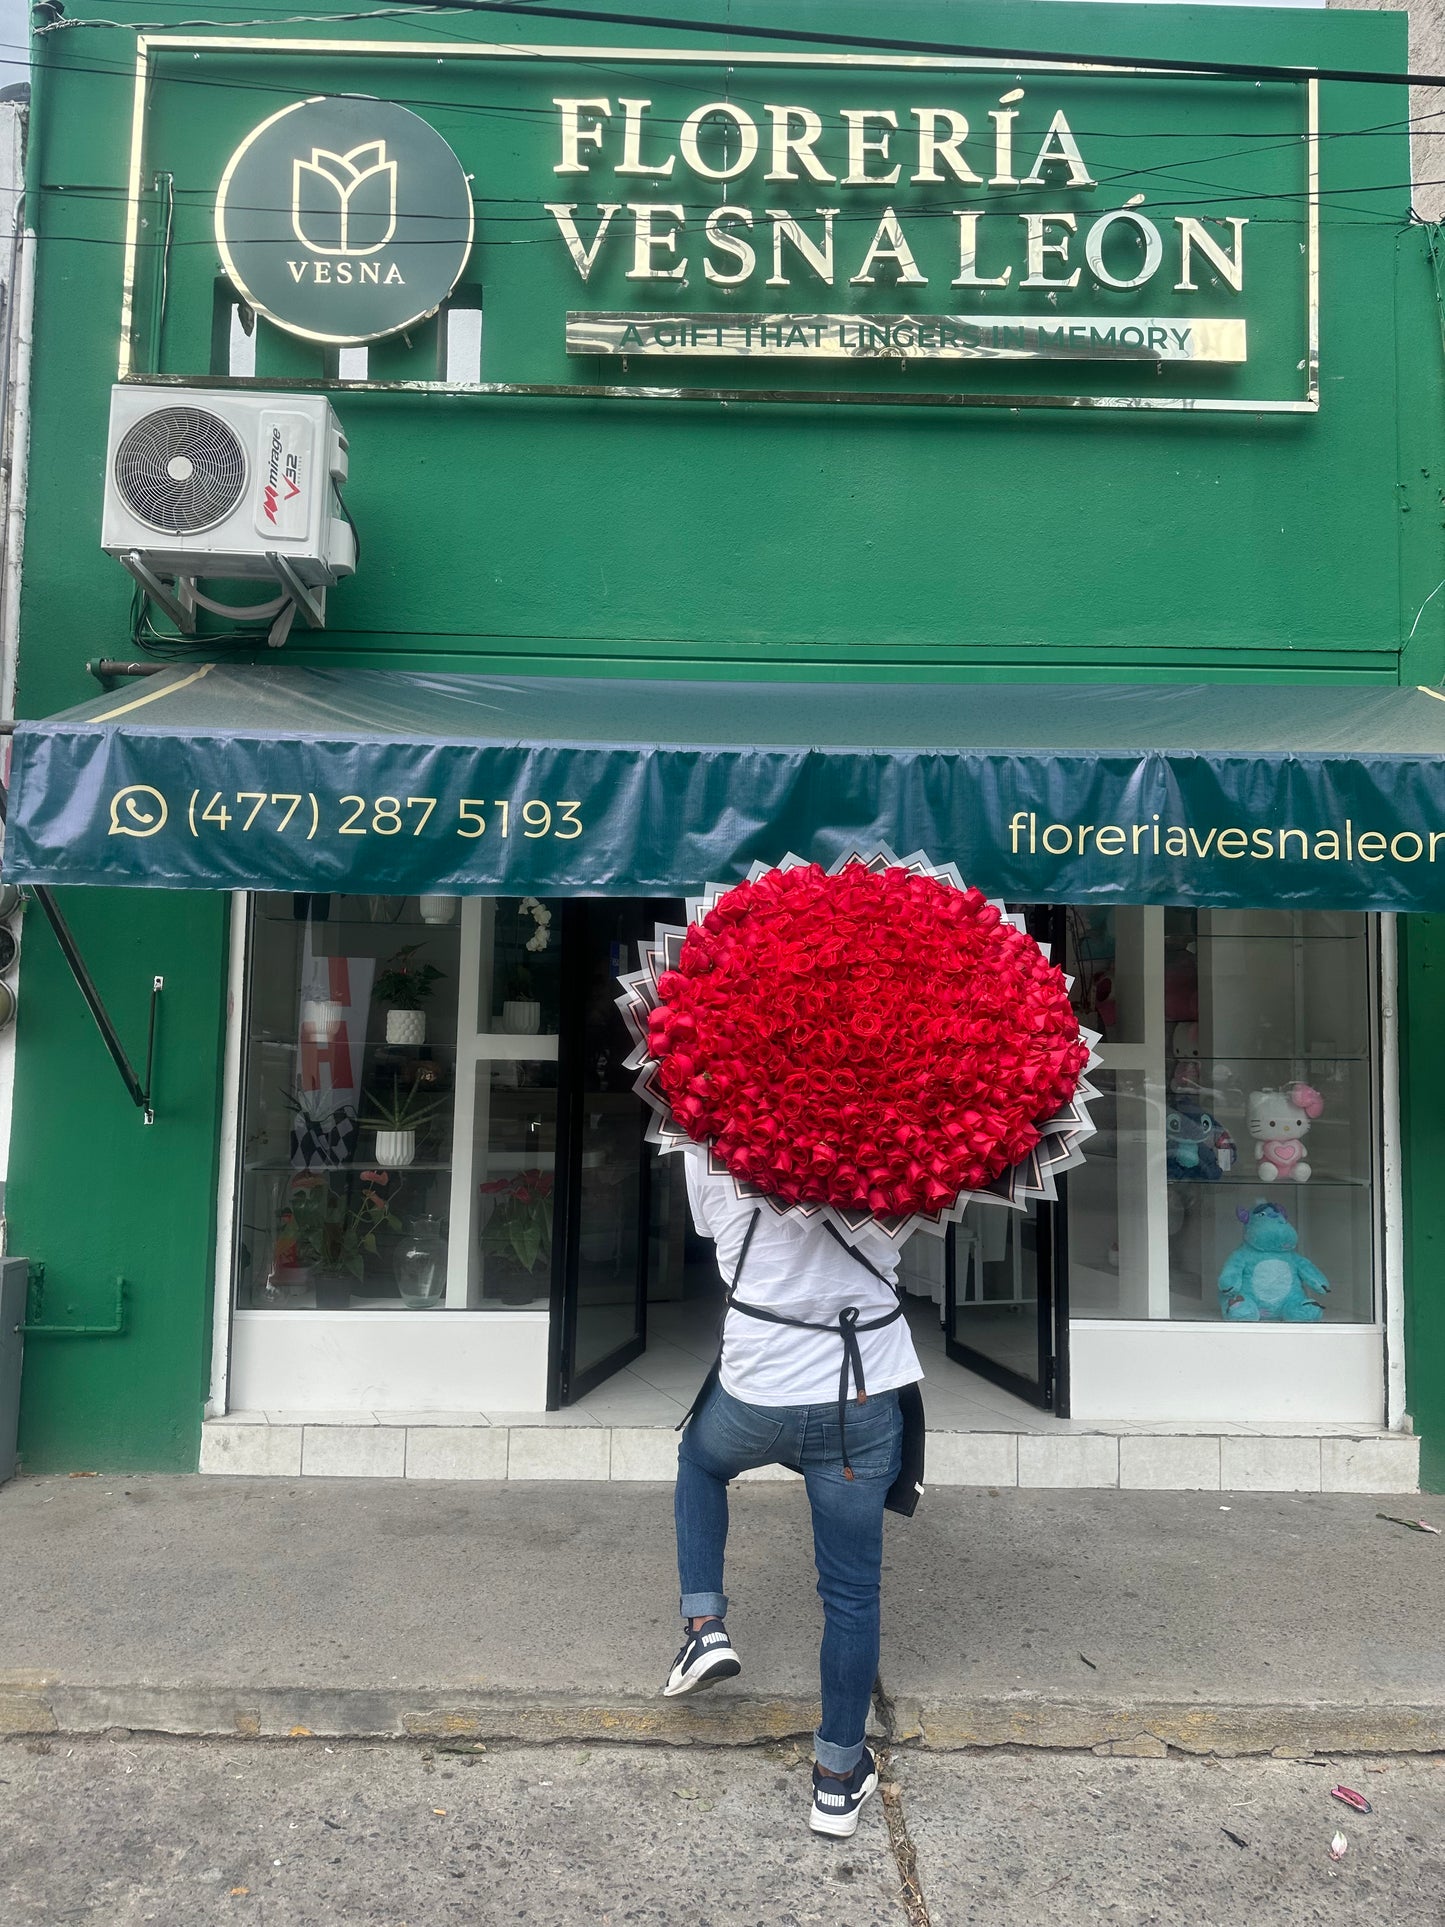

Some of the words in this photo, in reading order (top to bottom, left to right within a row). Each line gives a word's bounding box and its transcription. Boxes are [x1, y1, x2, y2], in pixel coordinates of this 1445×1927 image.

[552, 88, 1098, 188] FLORERÍA
[544, 203, 928, 287] VESNA
[951, 193, 1250, 293] LEÓN
[286, 261, 406, 284] VESNA
[619, 323, 644, 347] A
[654, 323, 729, 347] GIFT
[738, 323, 828, 348] THAT
[839, 324, 981, 348] LINGERS
[992, 325, 1025, 349] IN
[1038, 326, 1192, 351] MEMORY
[188, 789, 318, 840] (477)
[338, 795, 438, 837] 287
[456, 799, 583, 840] 5193
[817, 1789, 846, 1807] PUMA
